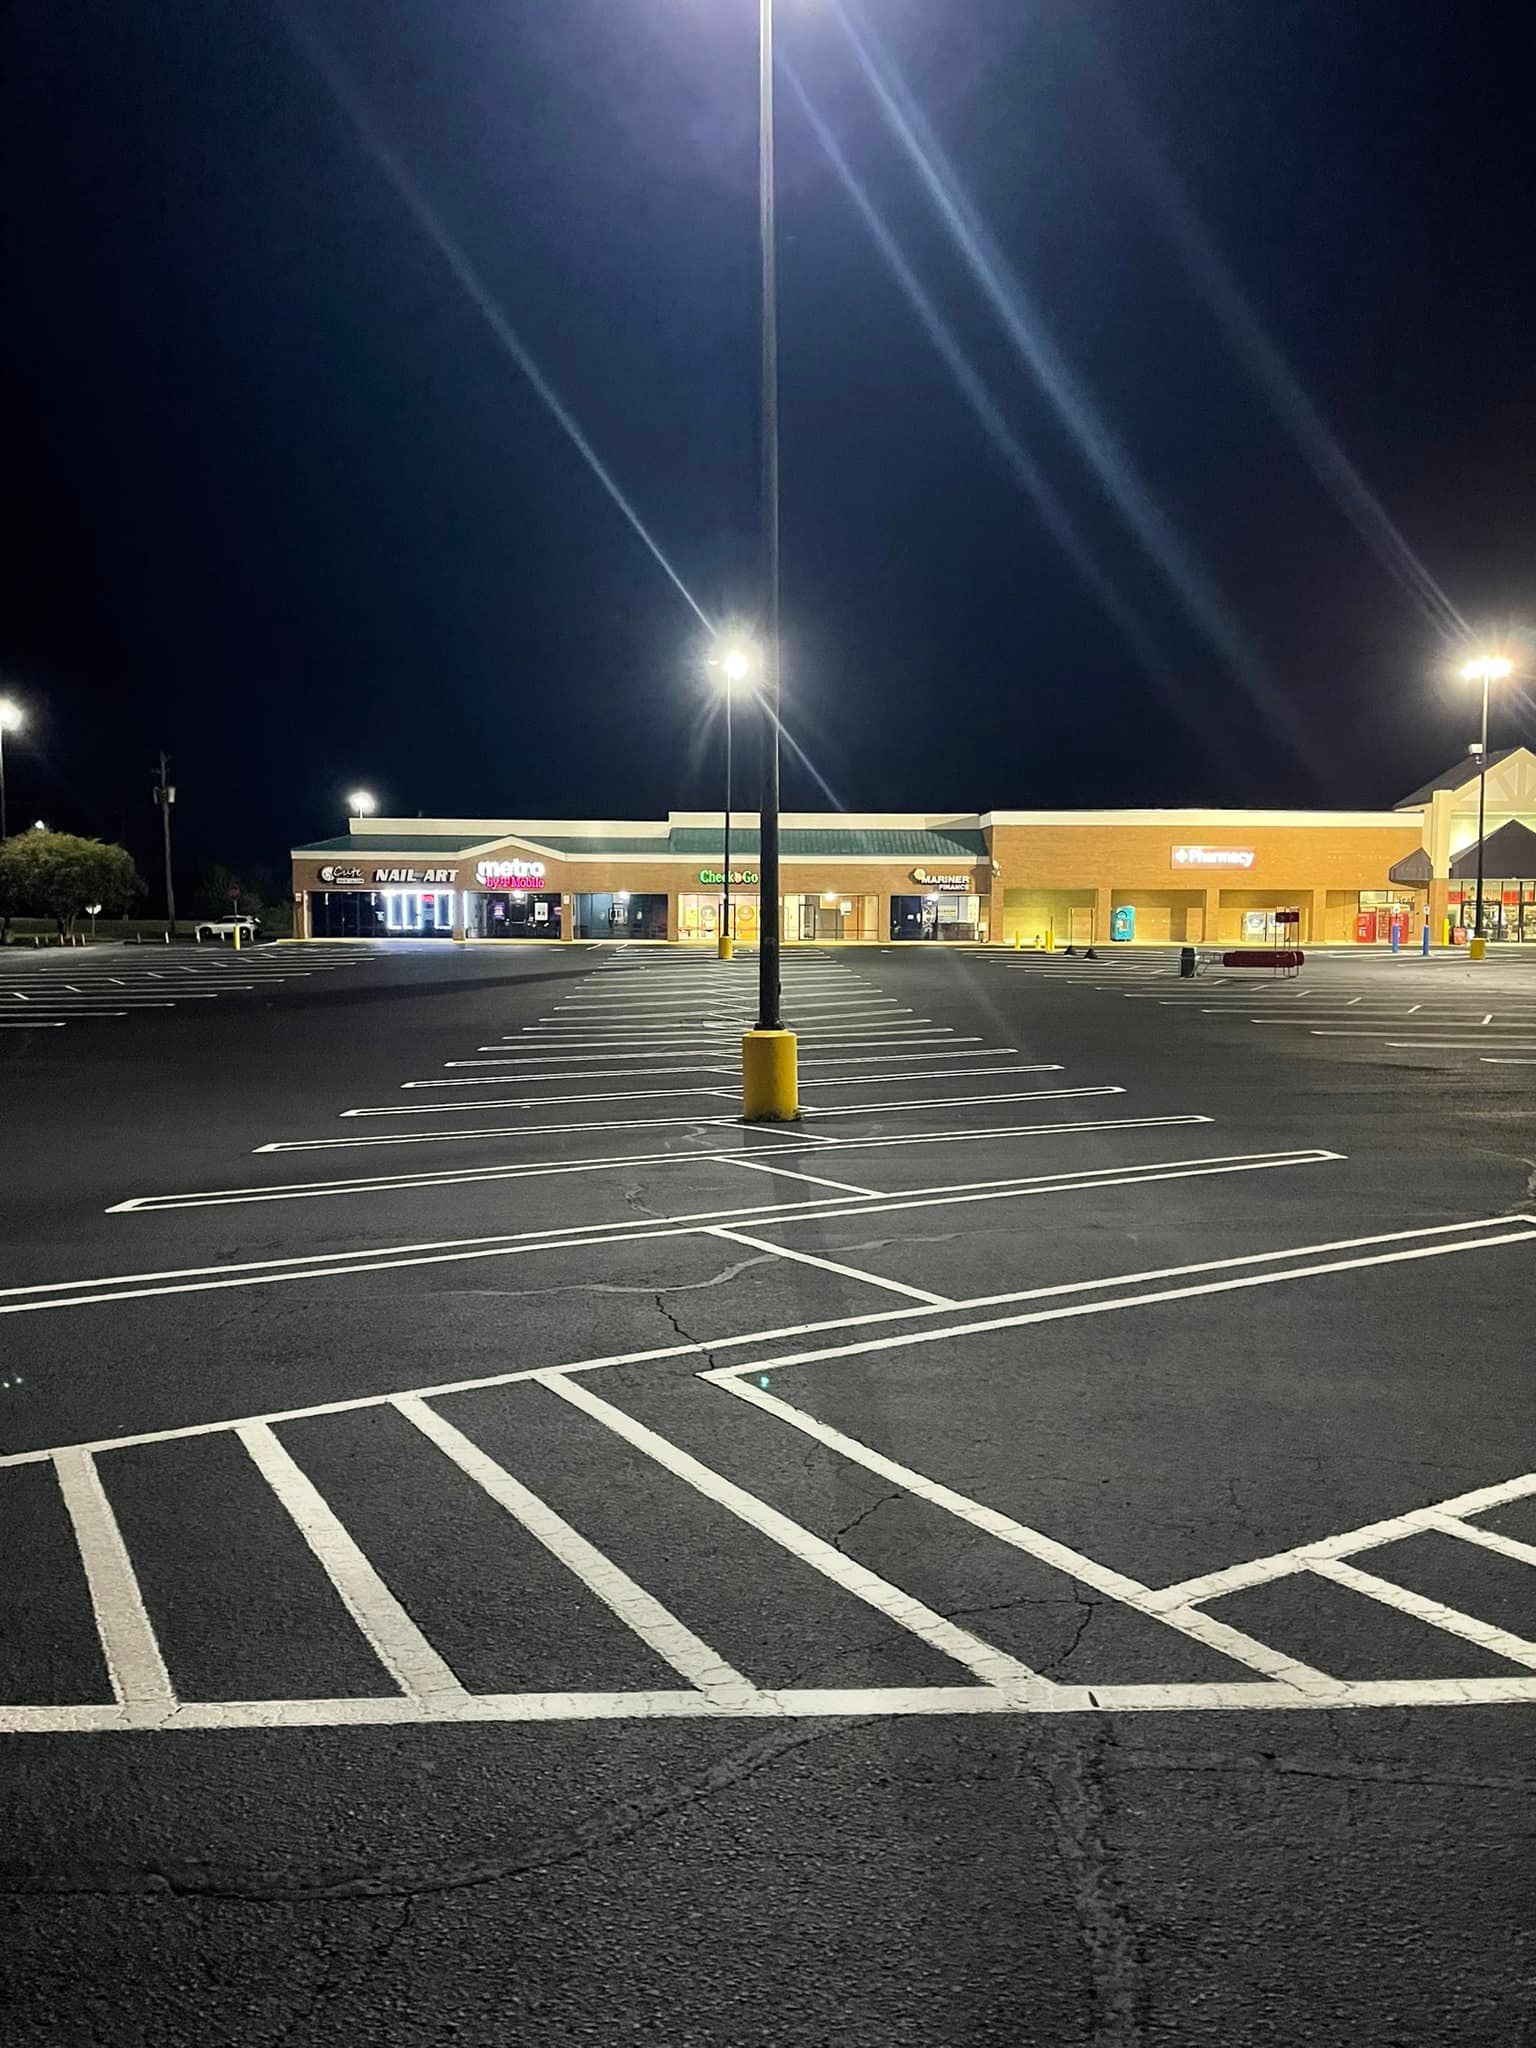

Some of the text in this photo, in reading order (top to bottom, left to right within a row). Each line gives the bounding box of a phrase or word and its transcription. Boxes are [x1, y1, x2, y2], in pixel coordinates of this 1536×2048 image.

[1188, 847, 1255, 868] Pharmacy
[375, 868, 417, 882] NAIL
[423, 868, 460, 882] ART
[475, 858, 546, 884] metro
[743, 870, 759, 883] Go
[486, 875, 500, 889] by
[921, 875, 970, 884] MARINER
